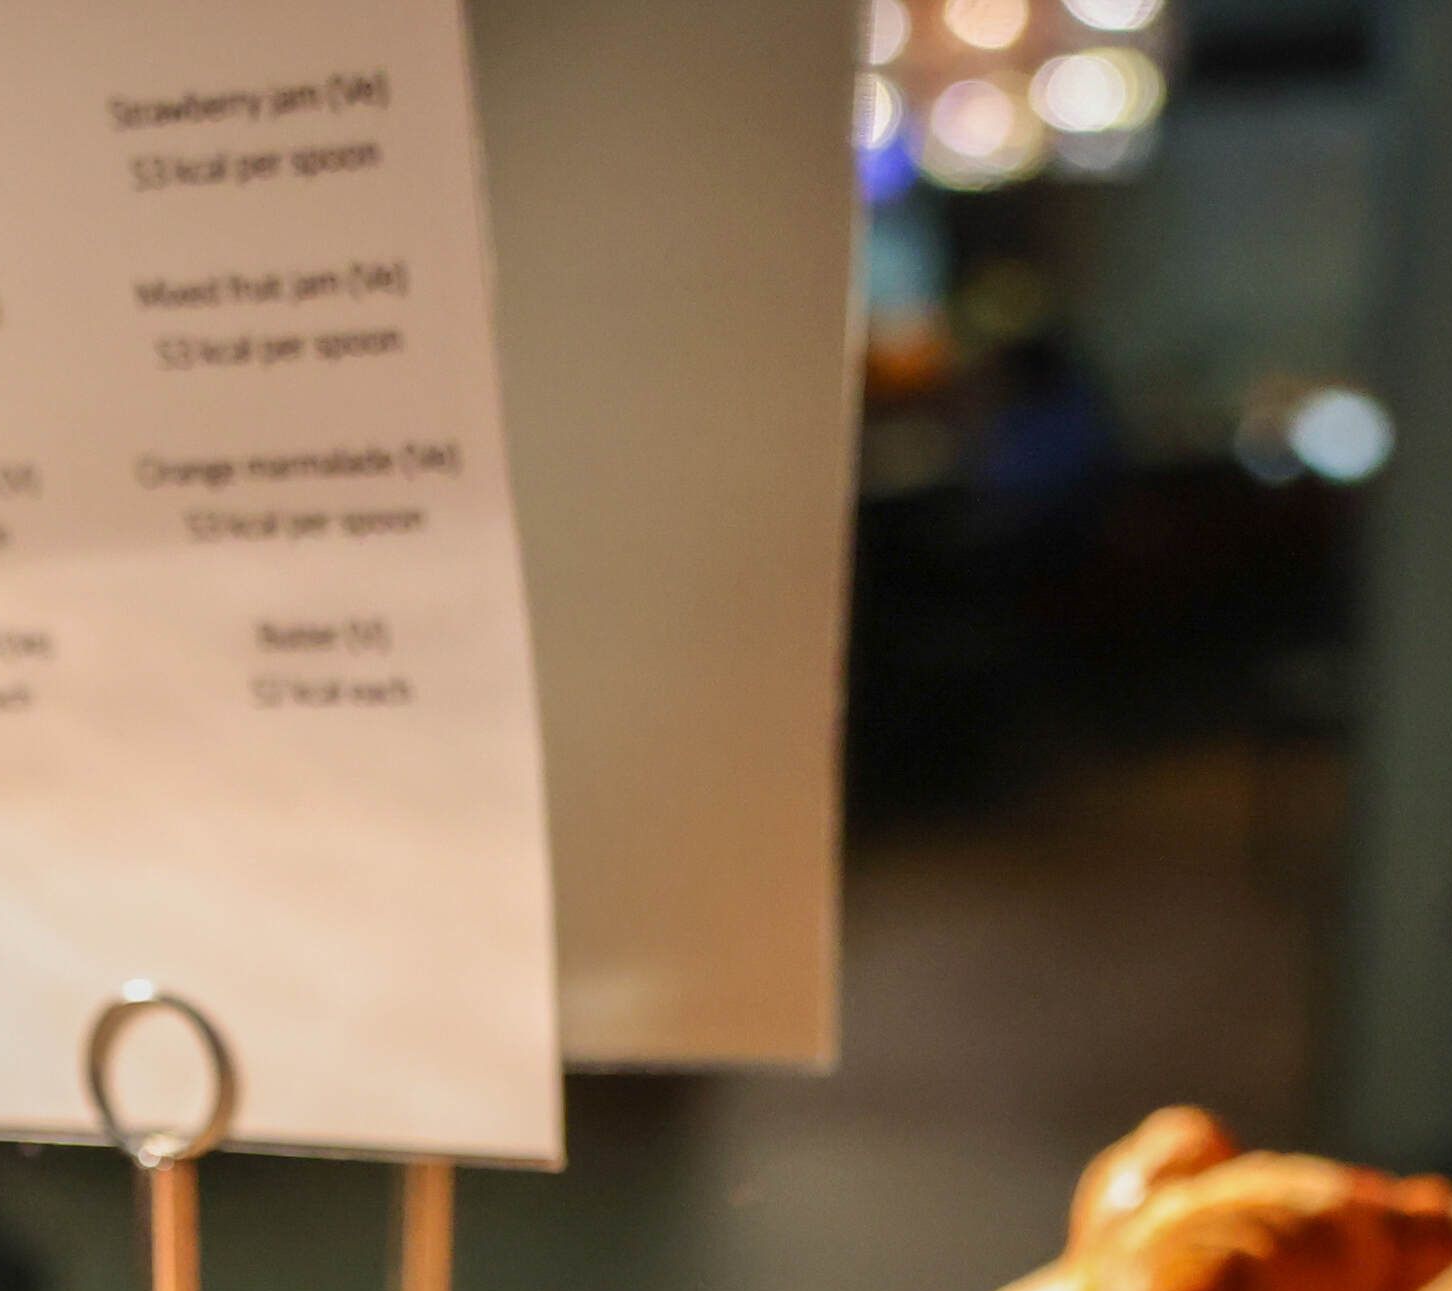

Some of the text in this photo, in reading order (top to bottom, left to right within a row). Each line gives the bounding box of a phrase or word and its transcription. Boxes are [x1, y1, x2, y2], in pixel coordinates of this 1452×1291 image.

[105, 90, 262, 131] Strawberry
[267, 83, 321, 119] jam
[234, 149, 283, 185] per
[288, 141, 382, 179] spoon
[290, 271, 342, 306] jam
[257, 334, 306, 370] per
[311, 325, 402, 361] spoon
[136, 451, 237, 490] Orange
